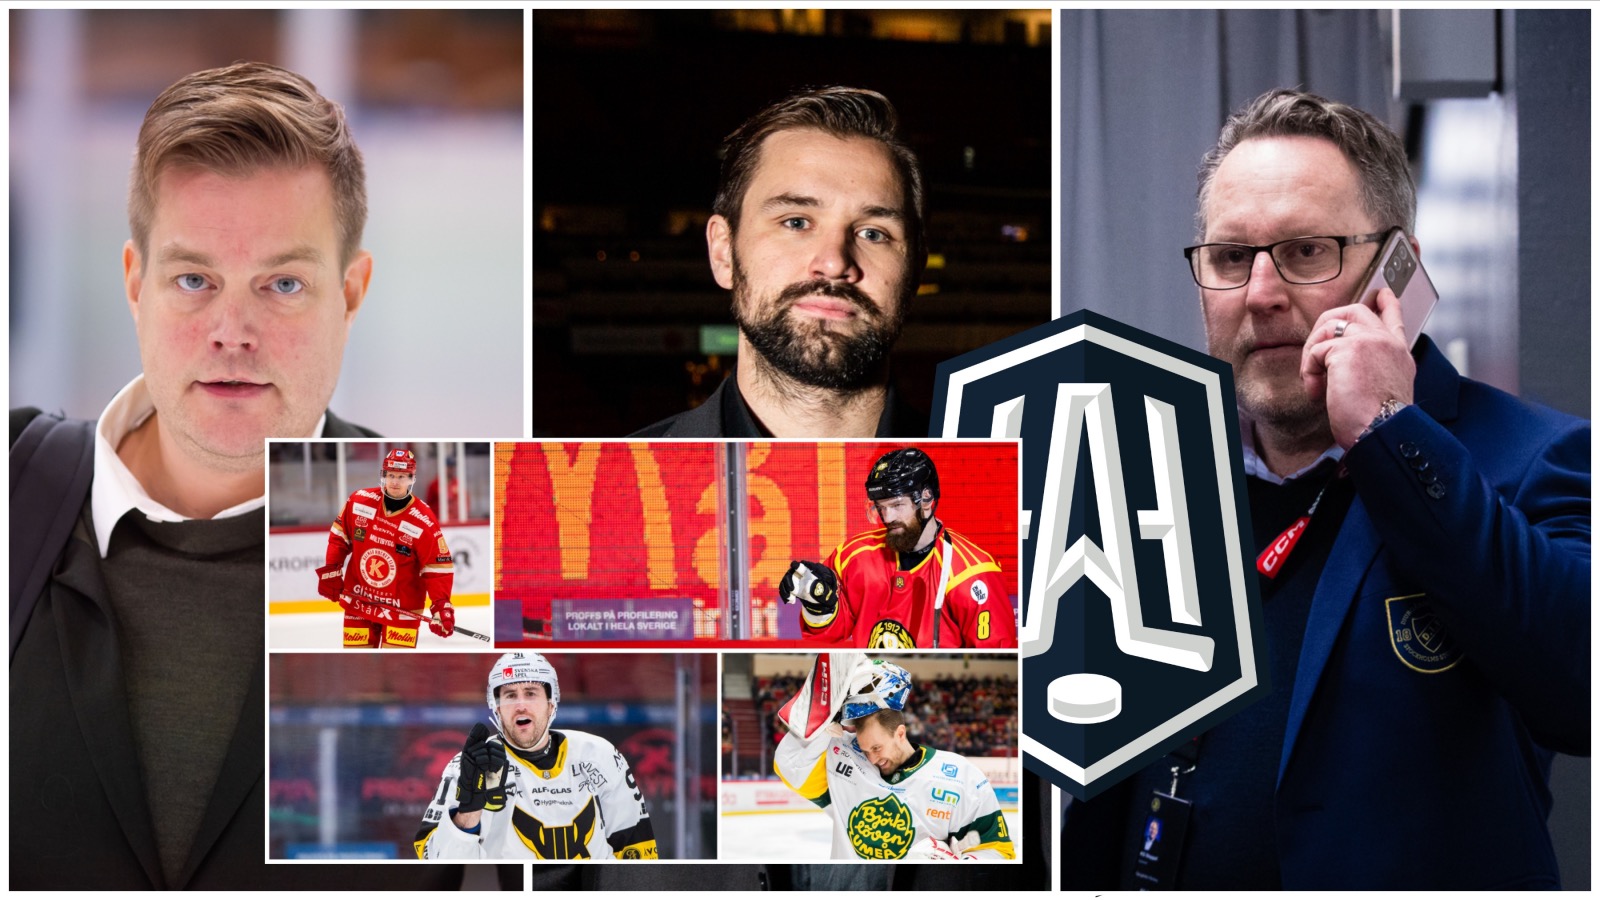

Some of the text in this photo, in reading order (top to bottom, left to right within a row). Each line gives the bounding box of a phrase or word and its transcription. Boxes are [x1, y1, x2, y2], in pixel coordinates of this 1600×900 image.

[408, 506, 435, 528] Molins
[1262, 519, 1305, 573] CCM
[368, 558, 386, 579] K
[565, 609, 679, 621] PROFFS PÅ PROFILERING
[567, 620, 677, 631] LOKALT I HELA SVERIGE
[977, 610, 991, 641] 8
[883, 622, 901, 634] 1912
[1395, 628, 1412, 643] 18
[820, 661, 828, 706] CCM
[835, 761, 853, 778] UE
[853, 834, 898, 860] UMEÅ
